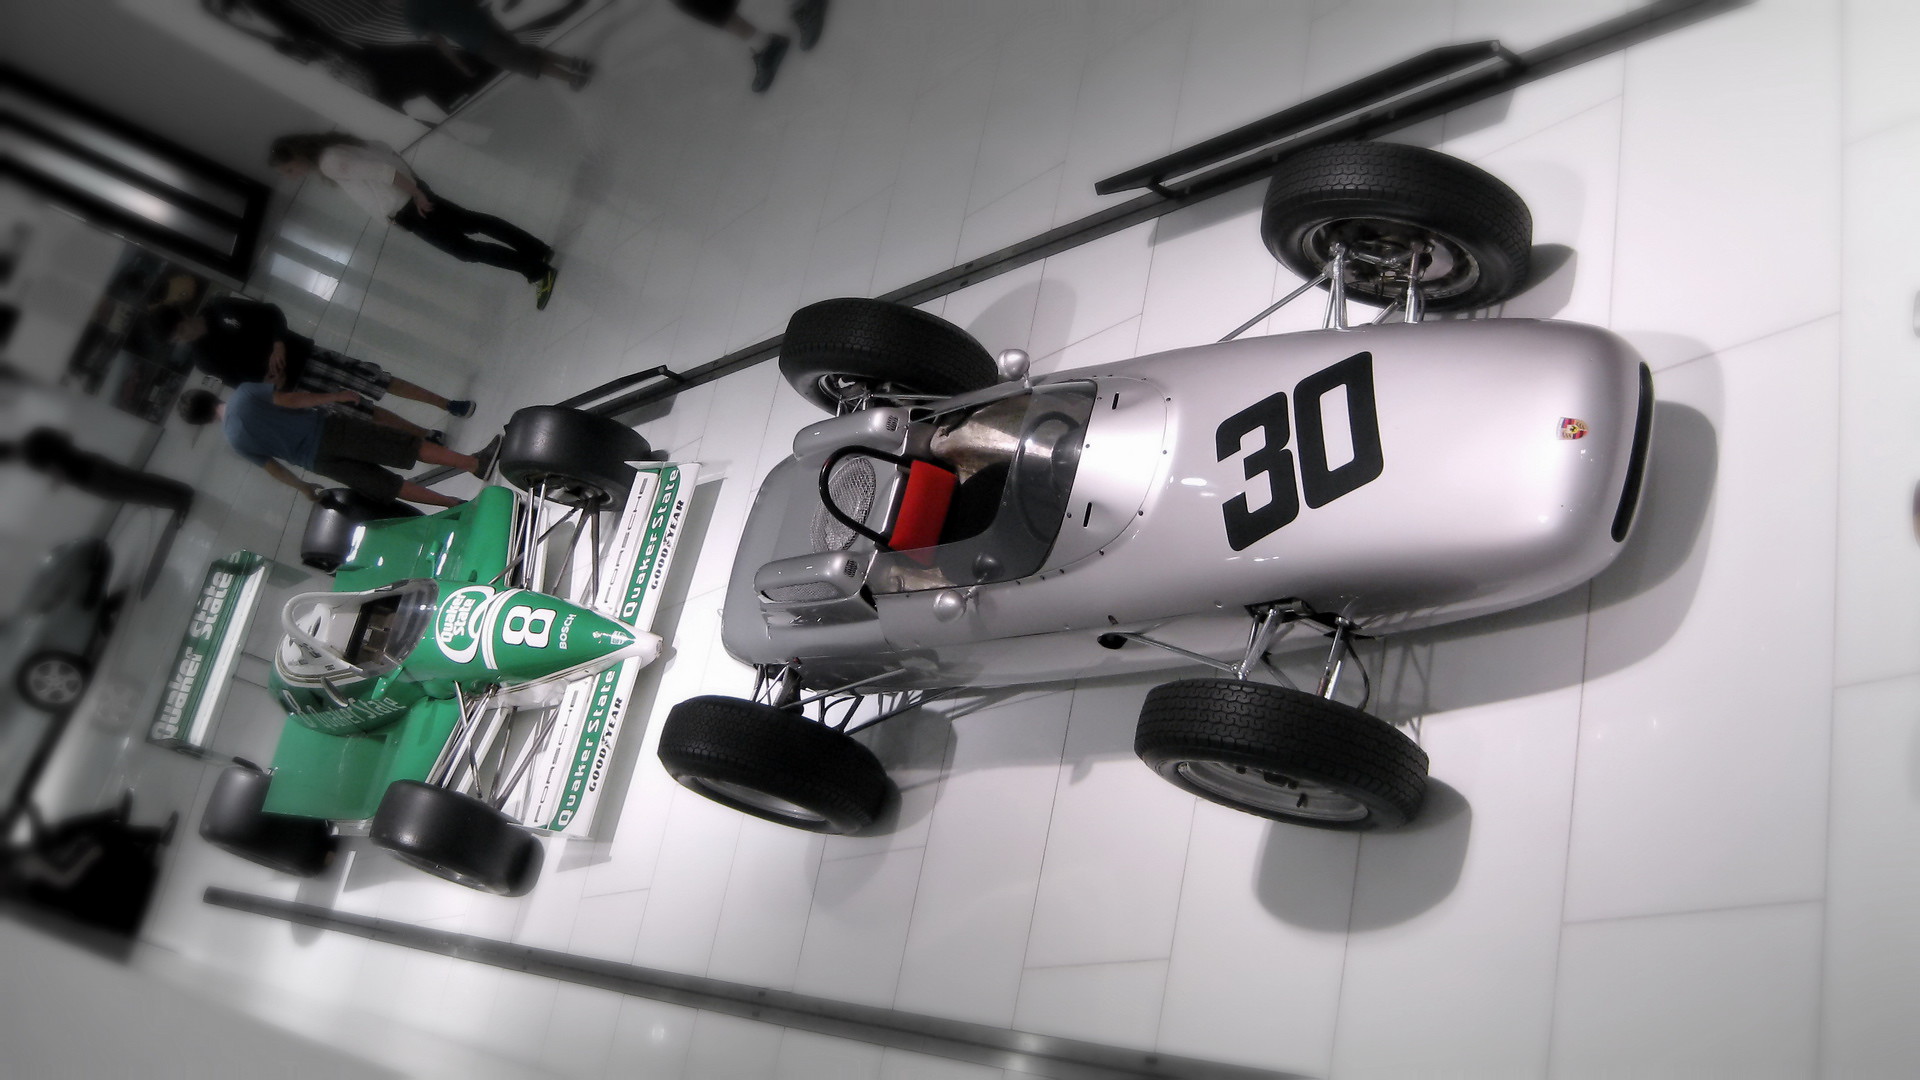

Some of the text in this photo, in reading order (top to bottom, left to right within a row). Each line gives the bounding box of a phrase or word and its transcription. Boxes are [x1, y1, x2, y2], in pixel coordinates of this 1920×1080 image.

[1215, 351, 1384, 552] 30
[623, 469, 680, 618] Quaker State
[651, 500, 684, 590] GOODYEAR
[151, 571, 233, 740] Quaker State
[440, 595, 467, 642] Quaker
[453, 599, 476, 636] State
[502, 605, 557, 648] 8
[559, 614, 577, 650] BOSCH
[558, 670, 615, 826] Quaker State
[589, 697, 622, 792] GOODYEAR
